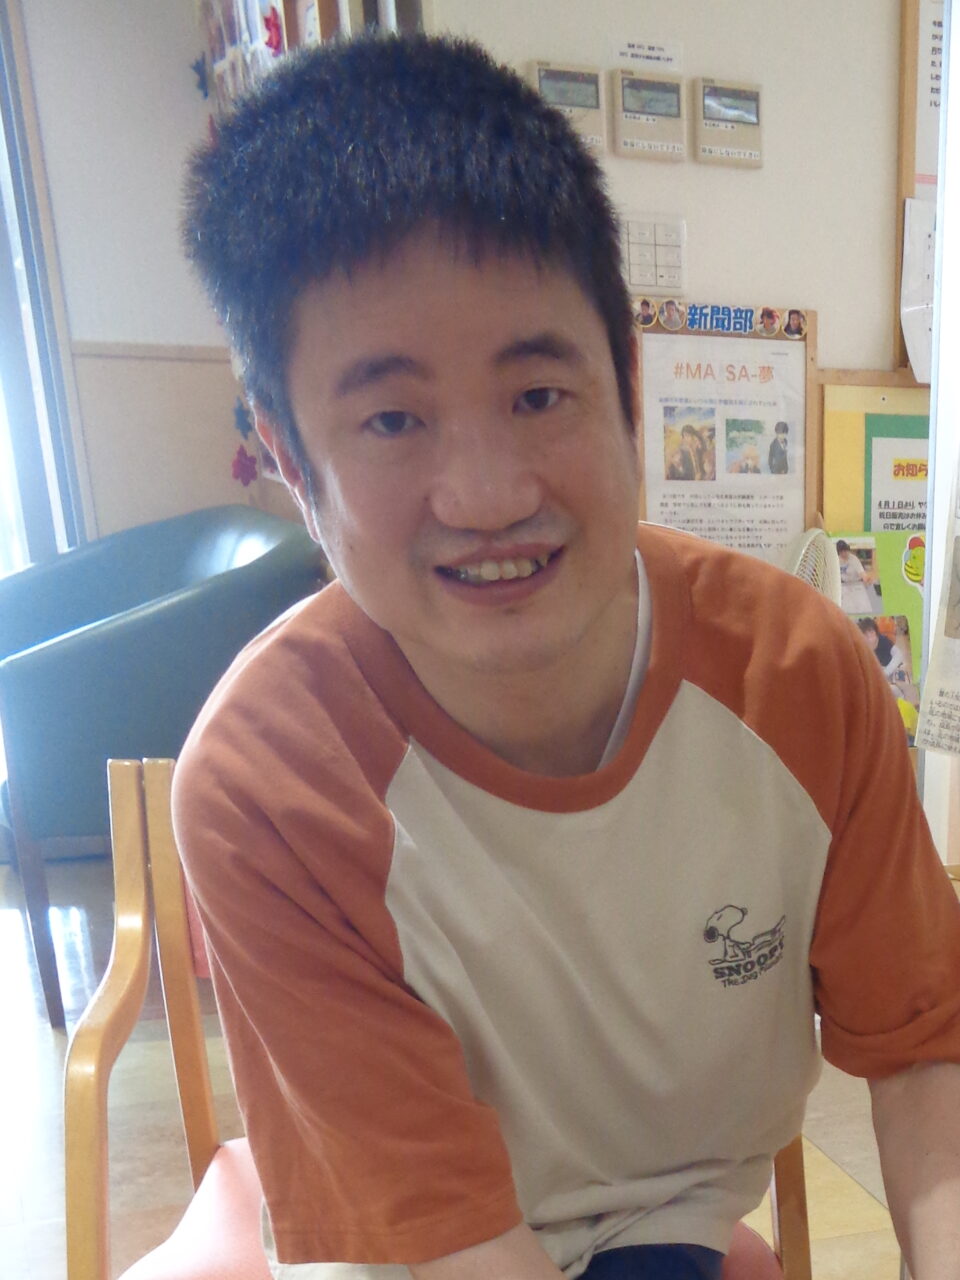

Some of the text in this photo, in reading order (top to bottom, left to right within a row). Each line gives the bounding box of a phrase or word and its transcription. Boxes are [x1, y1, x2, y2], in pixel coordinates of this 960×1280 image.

[687, 303, 755, 333] 新聞部
[674, 361, 716, 381] #MA
